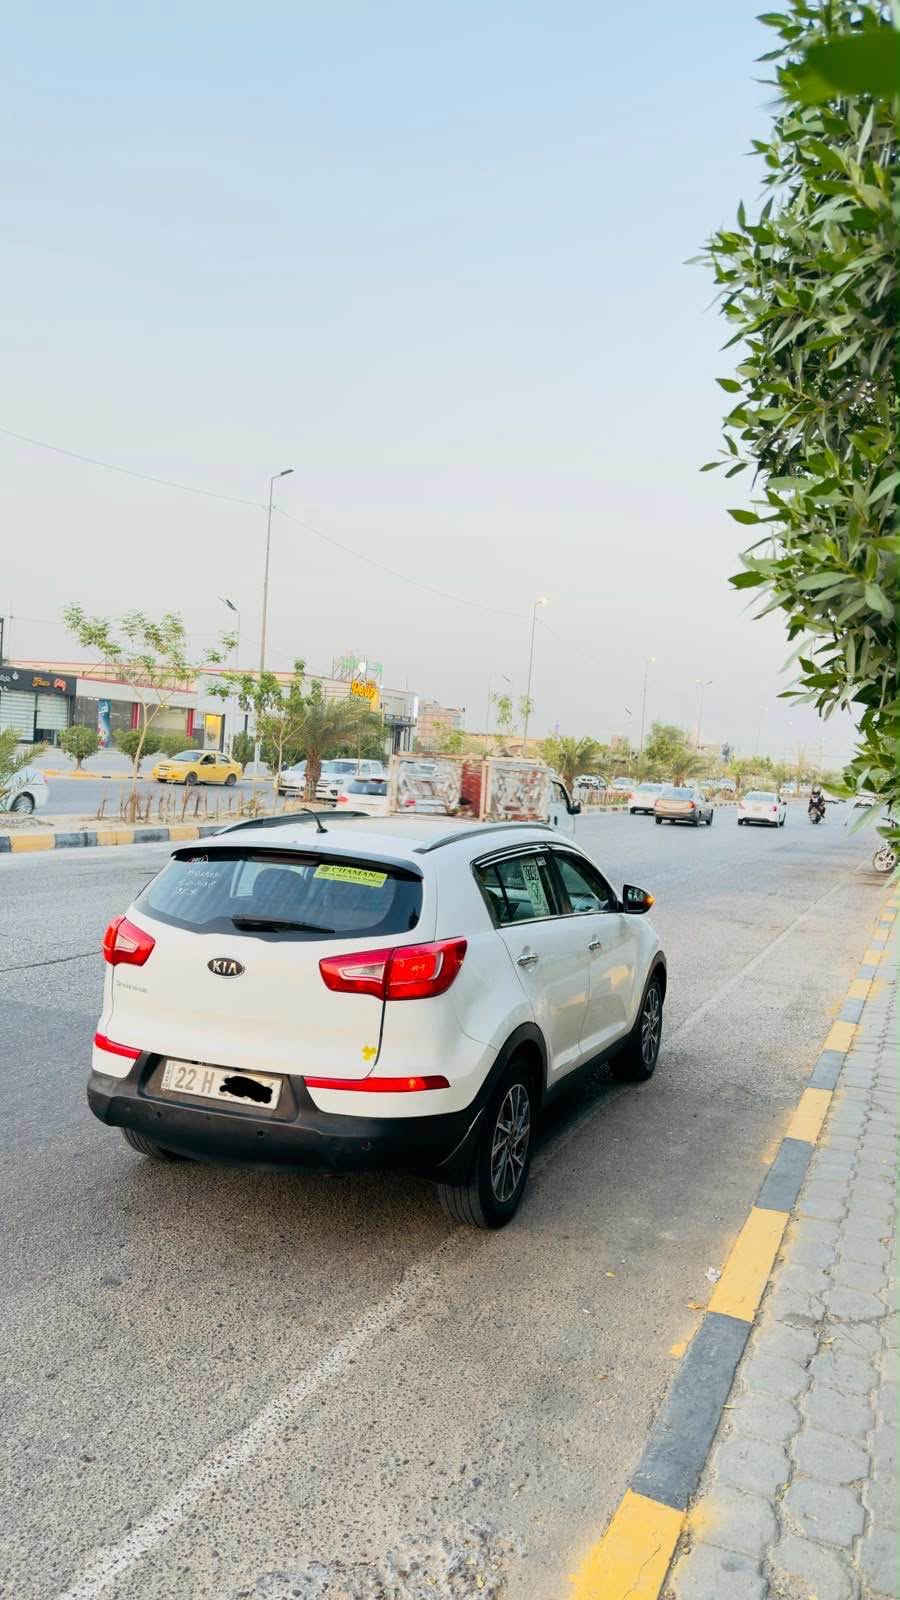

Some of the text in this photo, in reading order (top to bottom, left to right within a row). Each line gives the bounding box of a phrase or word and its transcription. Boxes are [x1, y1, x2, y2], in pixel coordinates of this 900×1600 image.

[211, 960, 238, 975] KIA
[175, 1066, 198, 1091] 22
[201, 1071, 216, 1094] H
